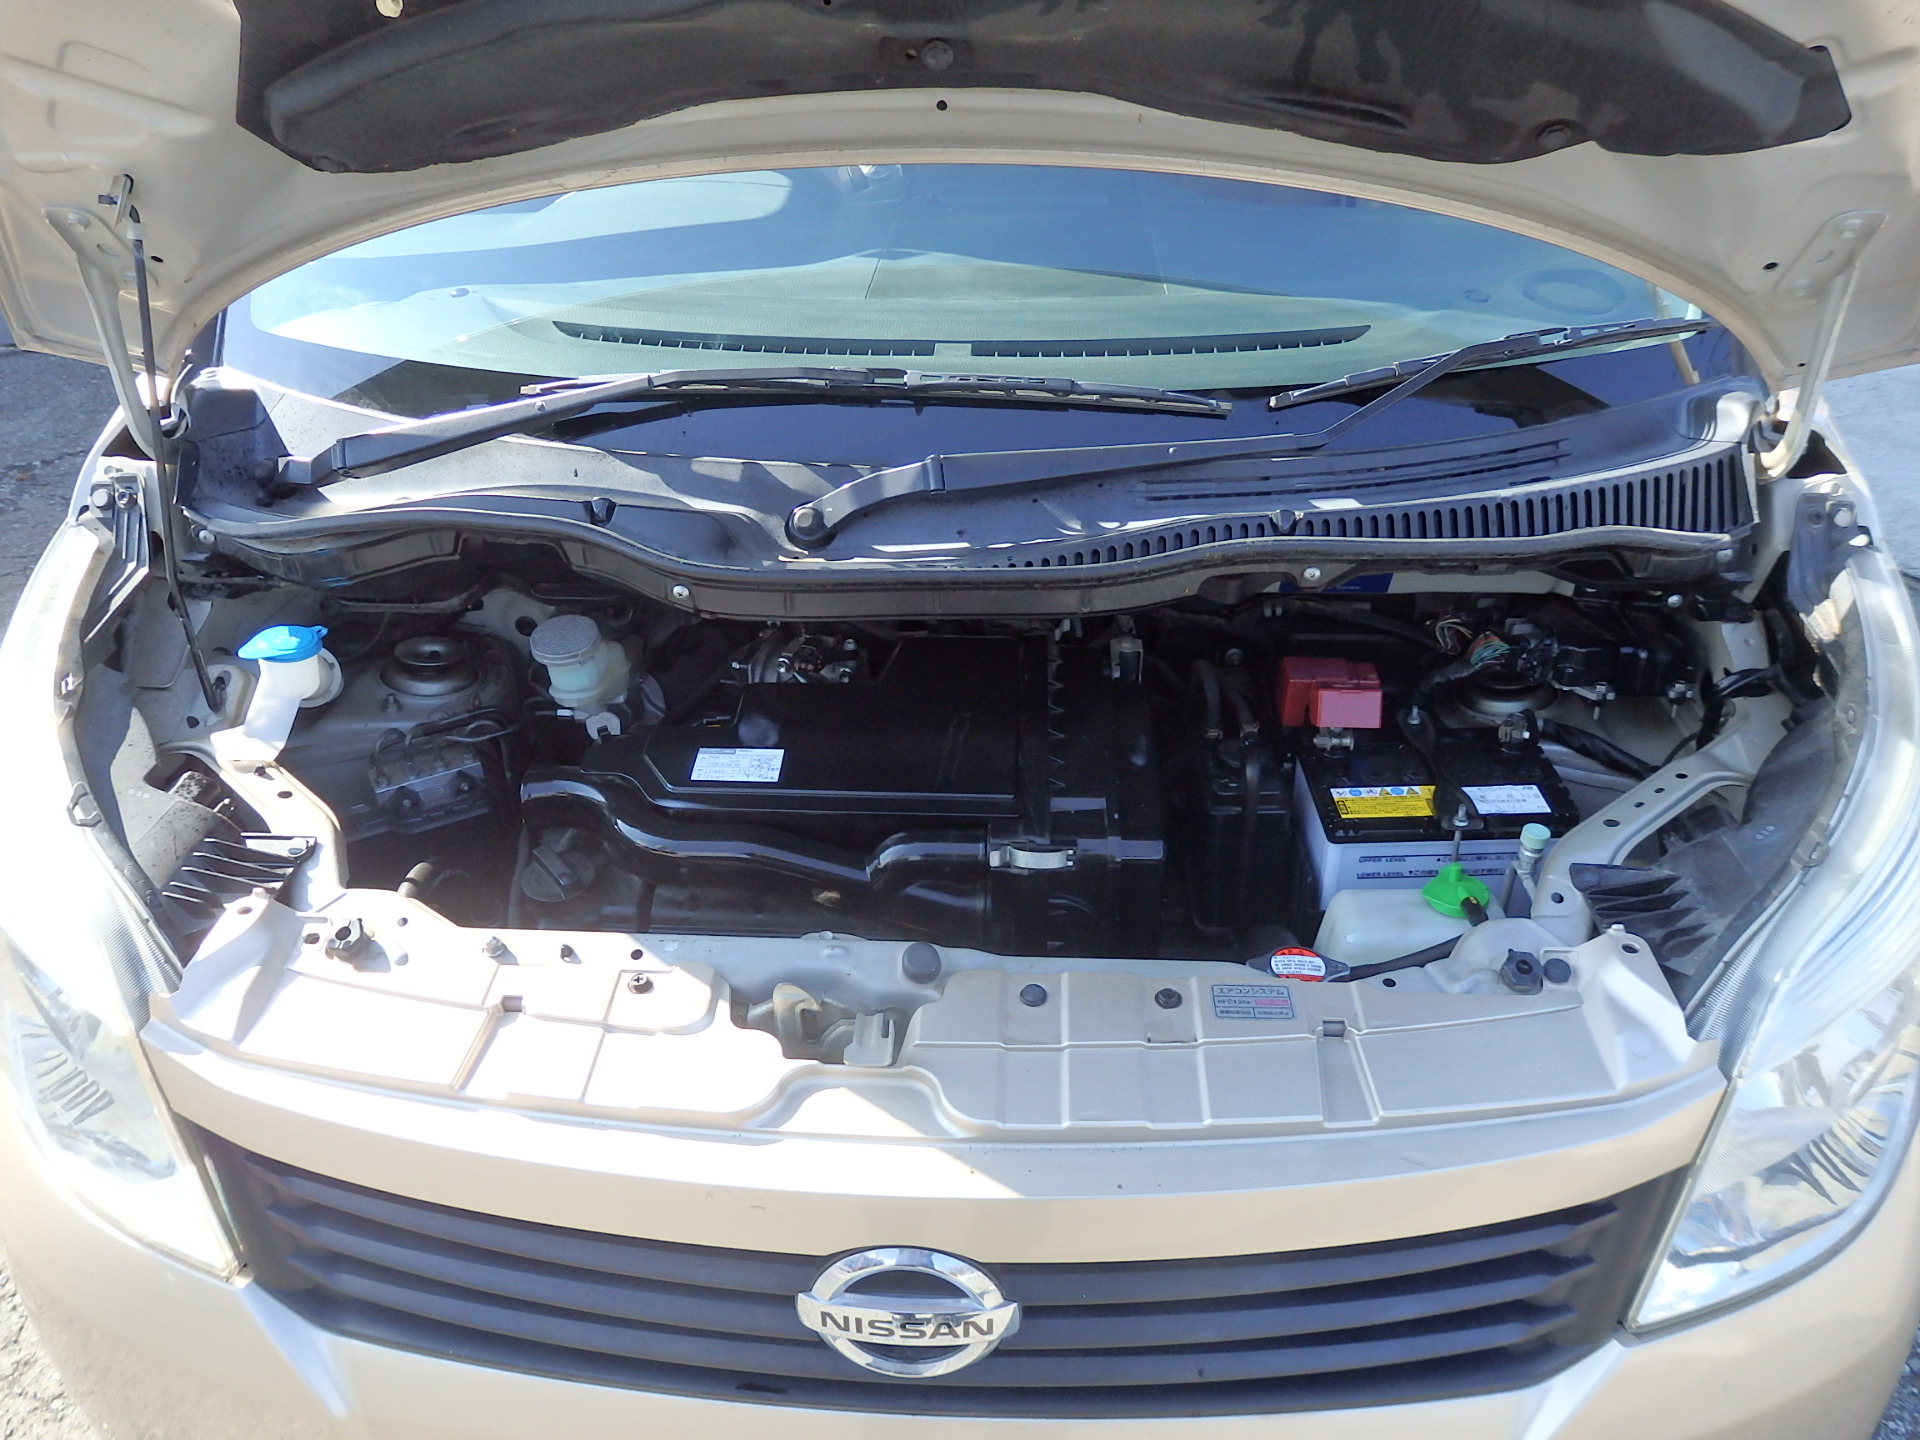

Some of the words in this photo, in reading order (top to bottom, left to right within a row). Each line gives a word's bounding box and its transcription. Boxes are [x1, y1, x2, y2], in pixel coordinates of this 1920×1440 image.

[1217, 987, 1285, 996] エアコンシステム
[820, 1310, 994, 1340] NISSAN
